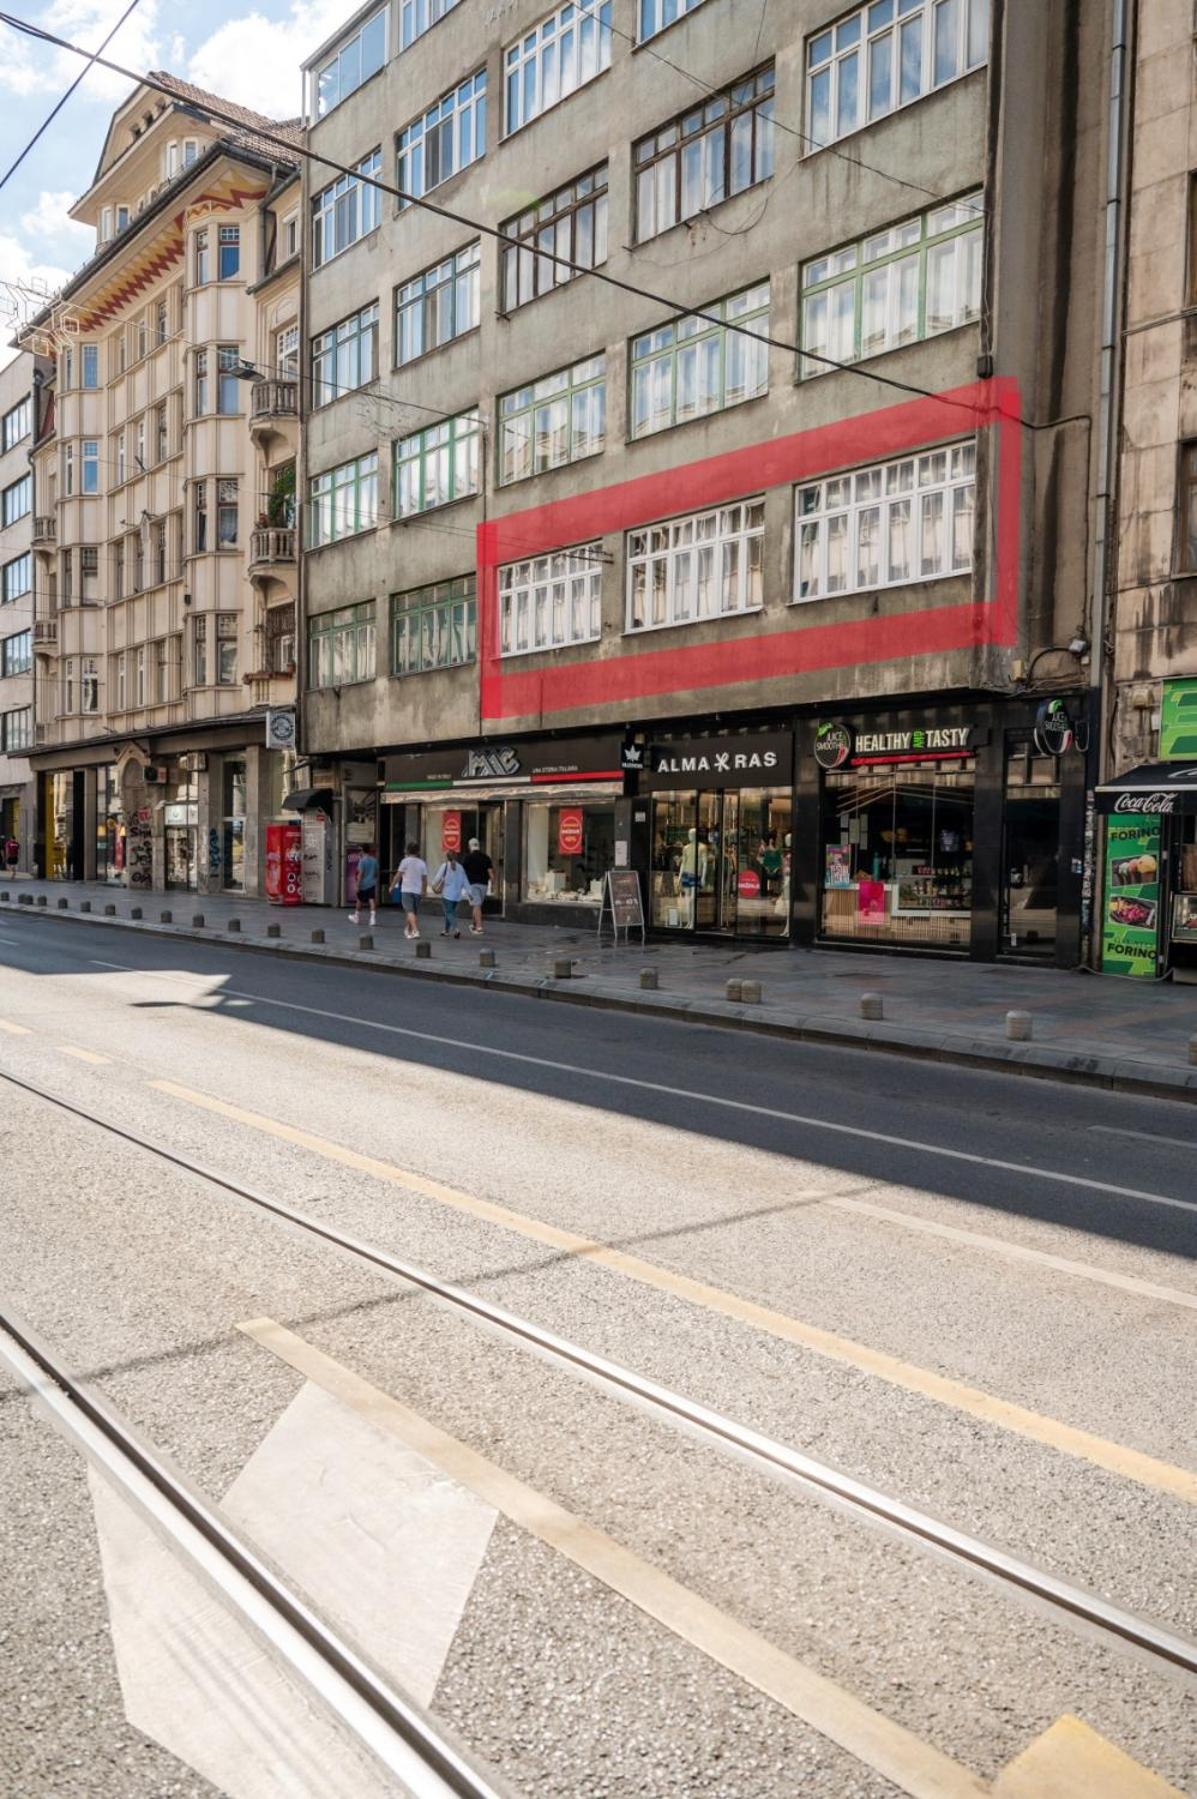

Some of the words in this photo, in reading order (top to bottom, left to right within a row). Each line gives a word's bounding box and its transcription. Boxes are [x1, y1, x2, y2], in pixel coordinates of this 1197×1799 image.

[855, 732, 911, 753] HEALTHY
[926, 728, 970, 747] TASTY
[658, 756, 710, 773] ALMA
[734, 752, 777, 769] RAS
[1114, 792, 1179, 814] Coca-Cola
[1110, 827, 1161, 841] FORINO
[1107, 943, 1157, 960] FORINO
